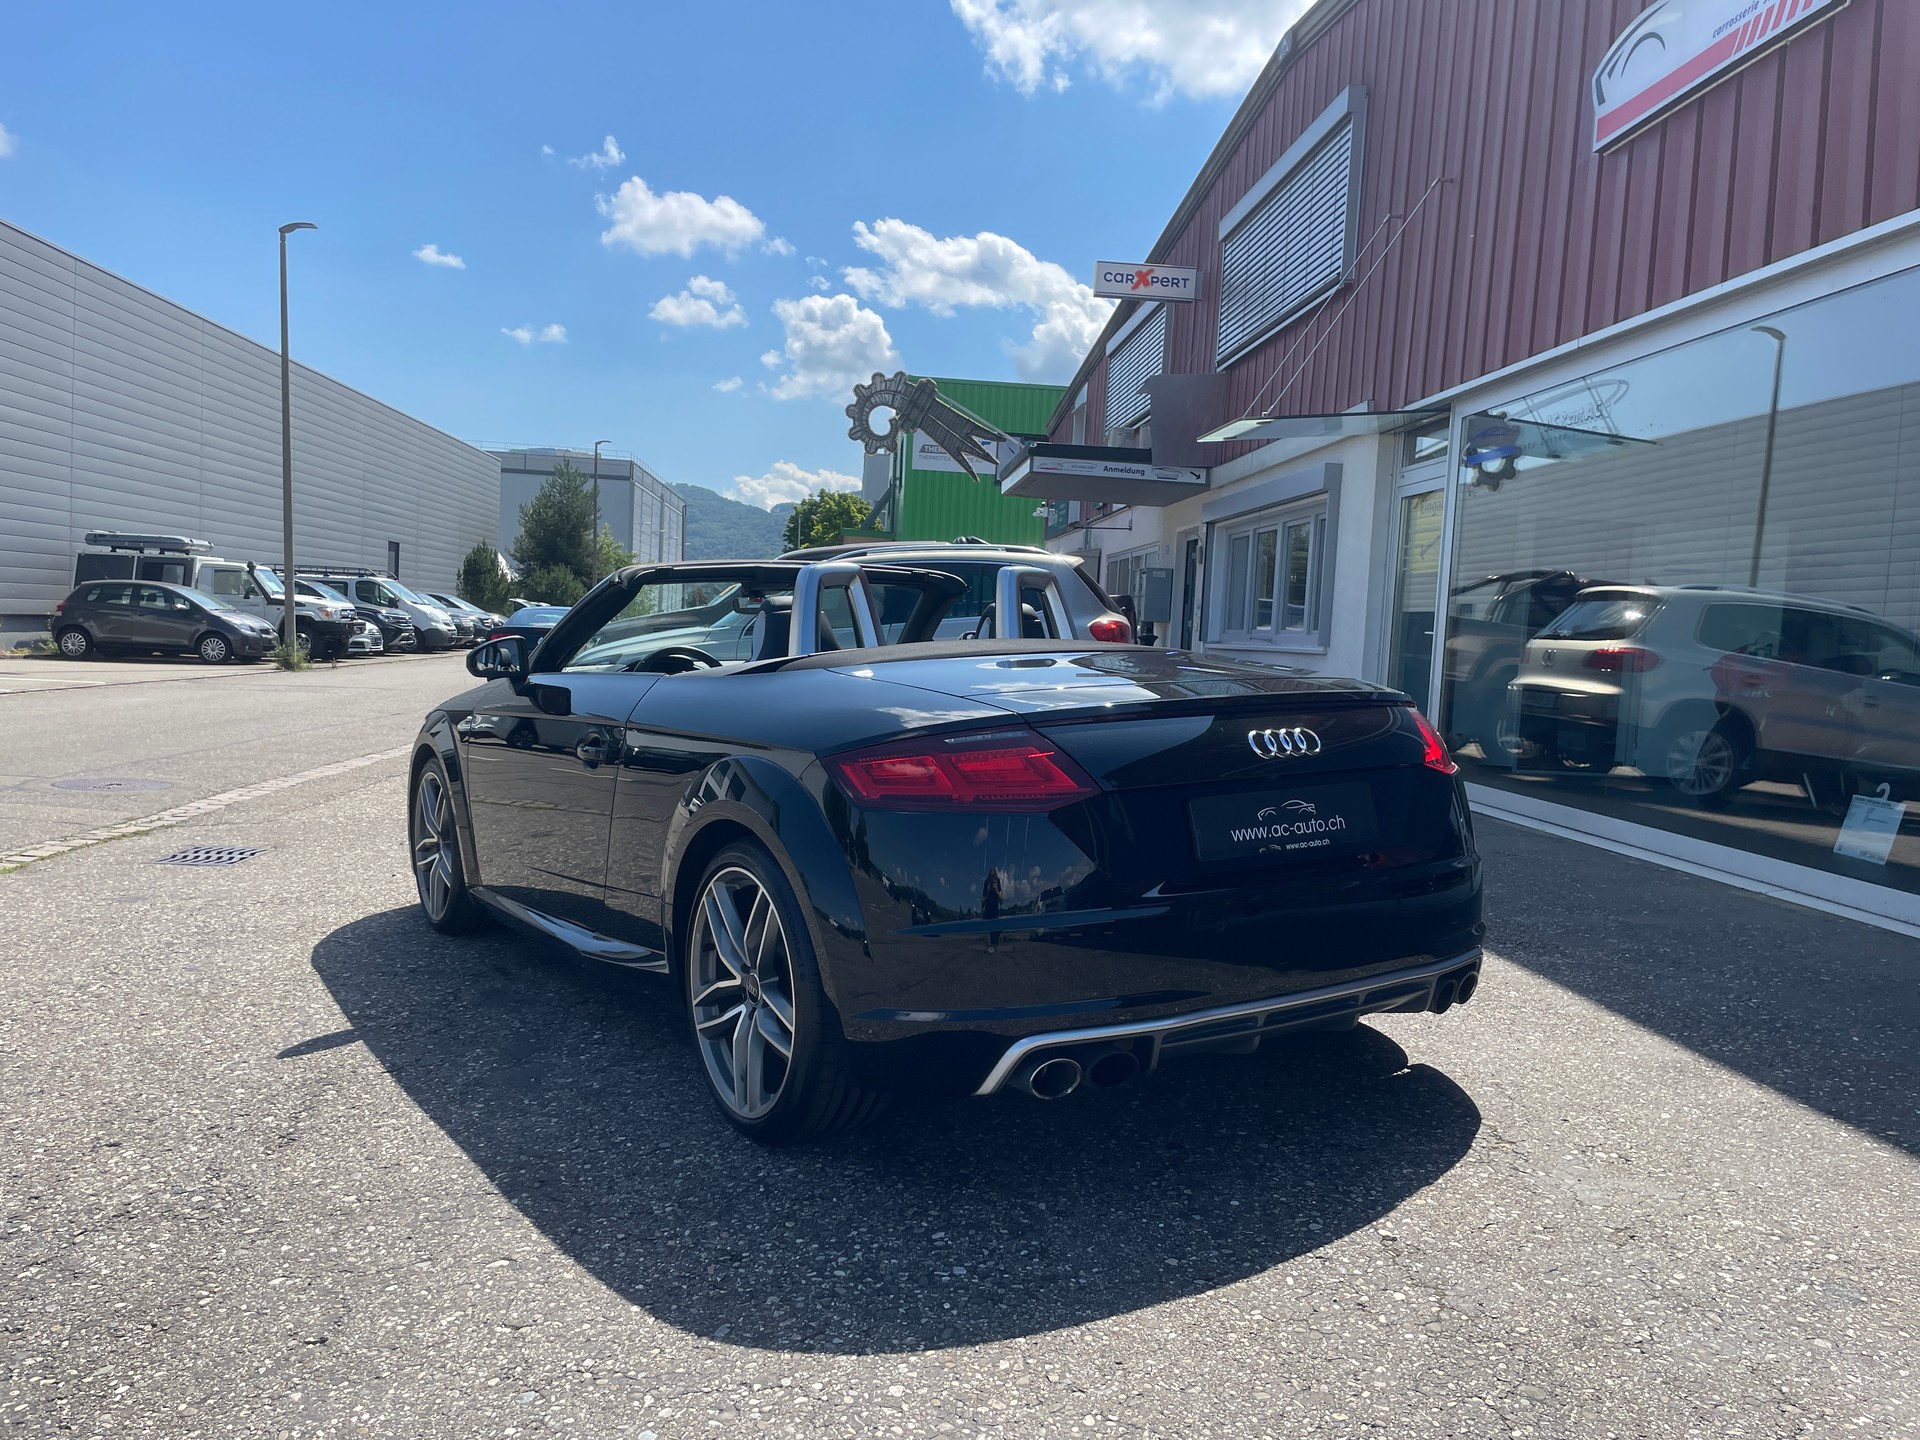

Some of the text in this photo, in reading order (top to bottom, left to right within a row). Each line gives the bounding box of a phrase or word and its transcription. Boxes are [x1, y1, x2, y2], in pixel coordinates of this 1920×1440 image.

[1712, 1, 1760, 39] carrosserie
[1103, 465, 1146, 476] Anmeldung
[1420, 499, 1442, 517] Einga
[1230, 814, 1346, 843] www.ac-auto.ch
[1285, 838, 1330, 850] www.ac-auto.ch
